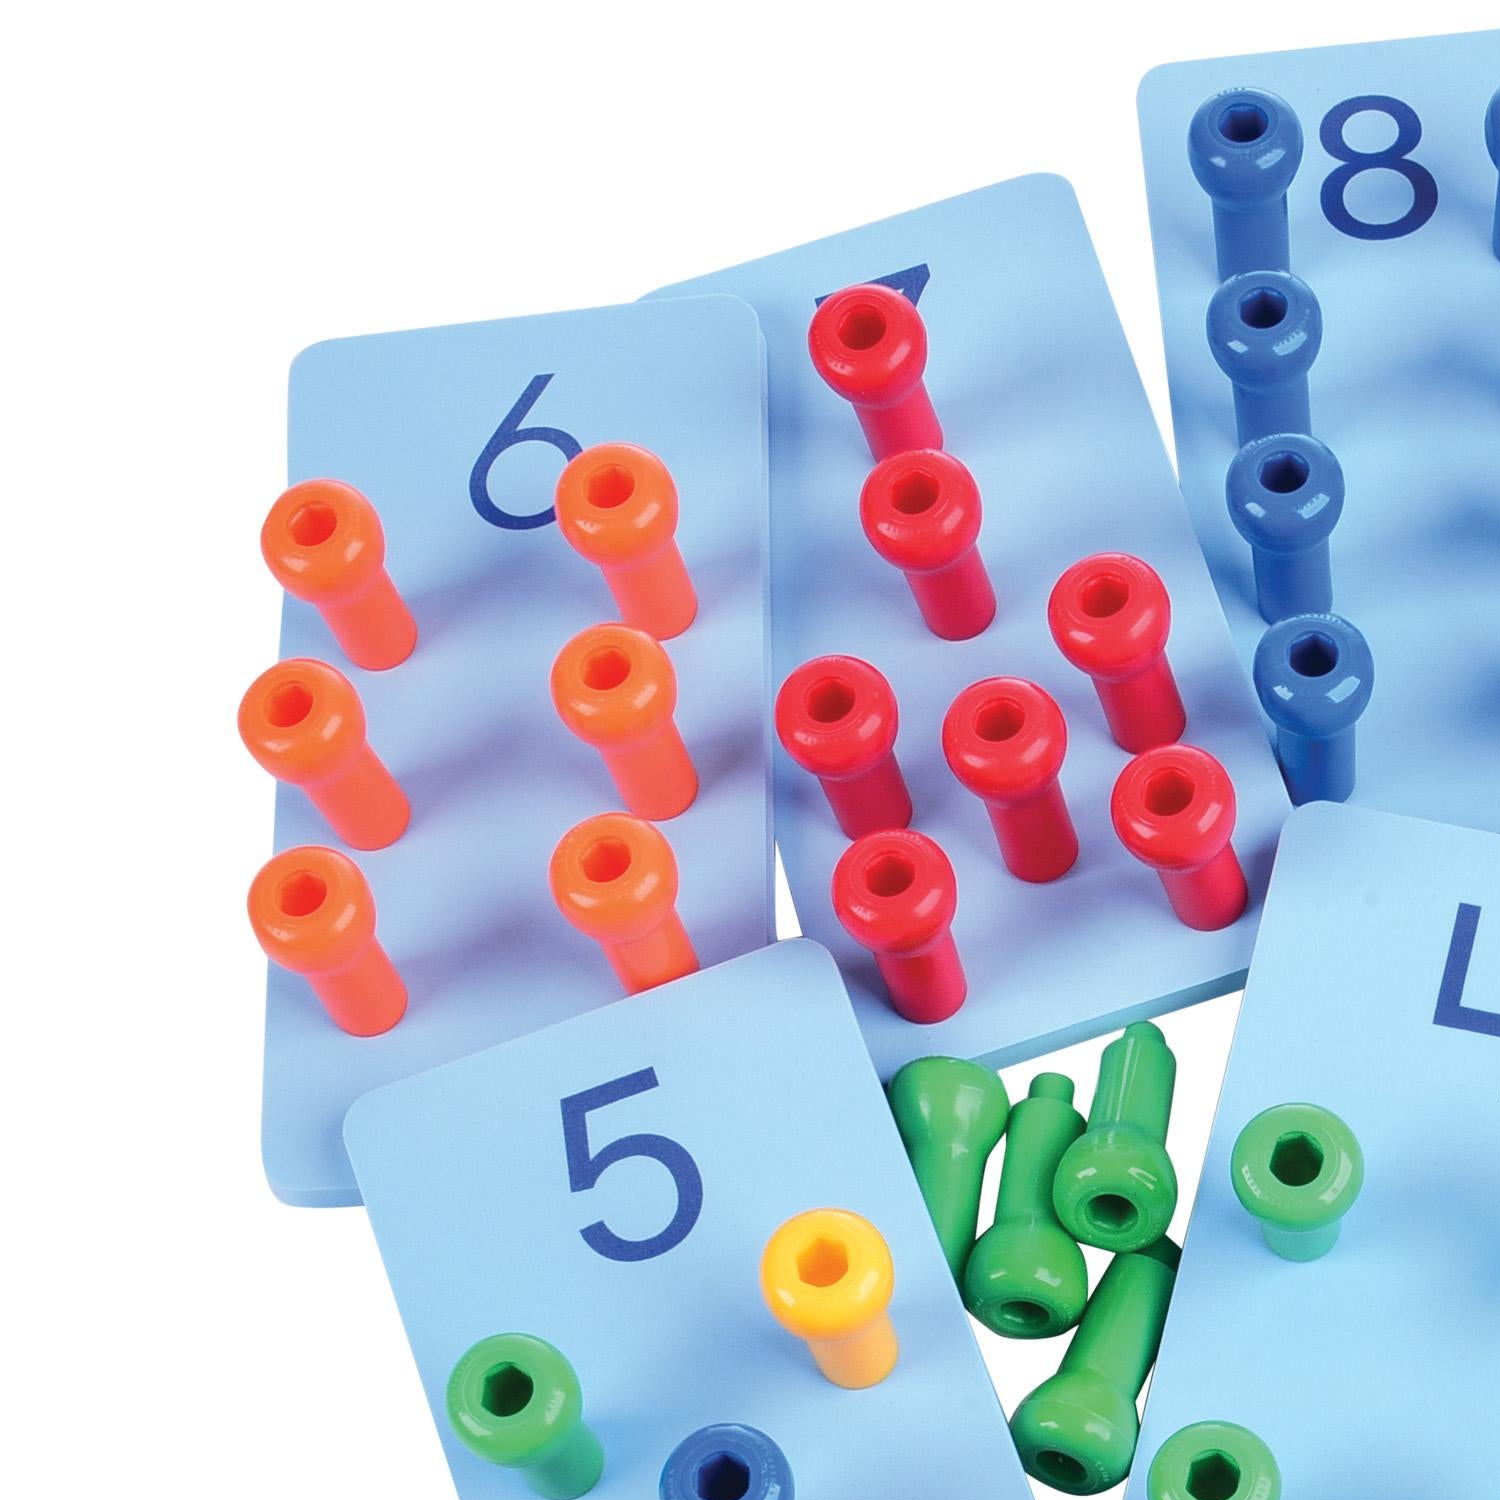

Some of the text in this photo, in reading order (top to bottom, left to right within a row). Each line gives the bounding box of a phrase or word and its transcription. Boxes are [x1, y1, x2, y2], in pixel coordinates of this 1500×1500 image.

[1319, 95, 1439, 241] 8
[469, 374, 582, 531] 6
[560, 1068, 702, 1262] 5
